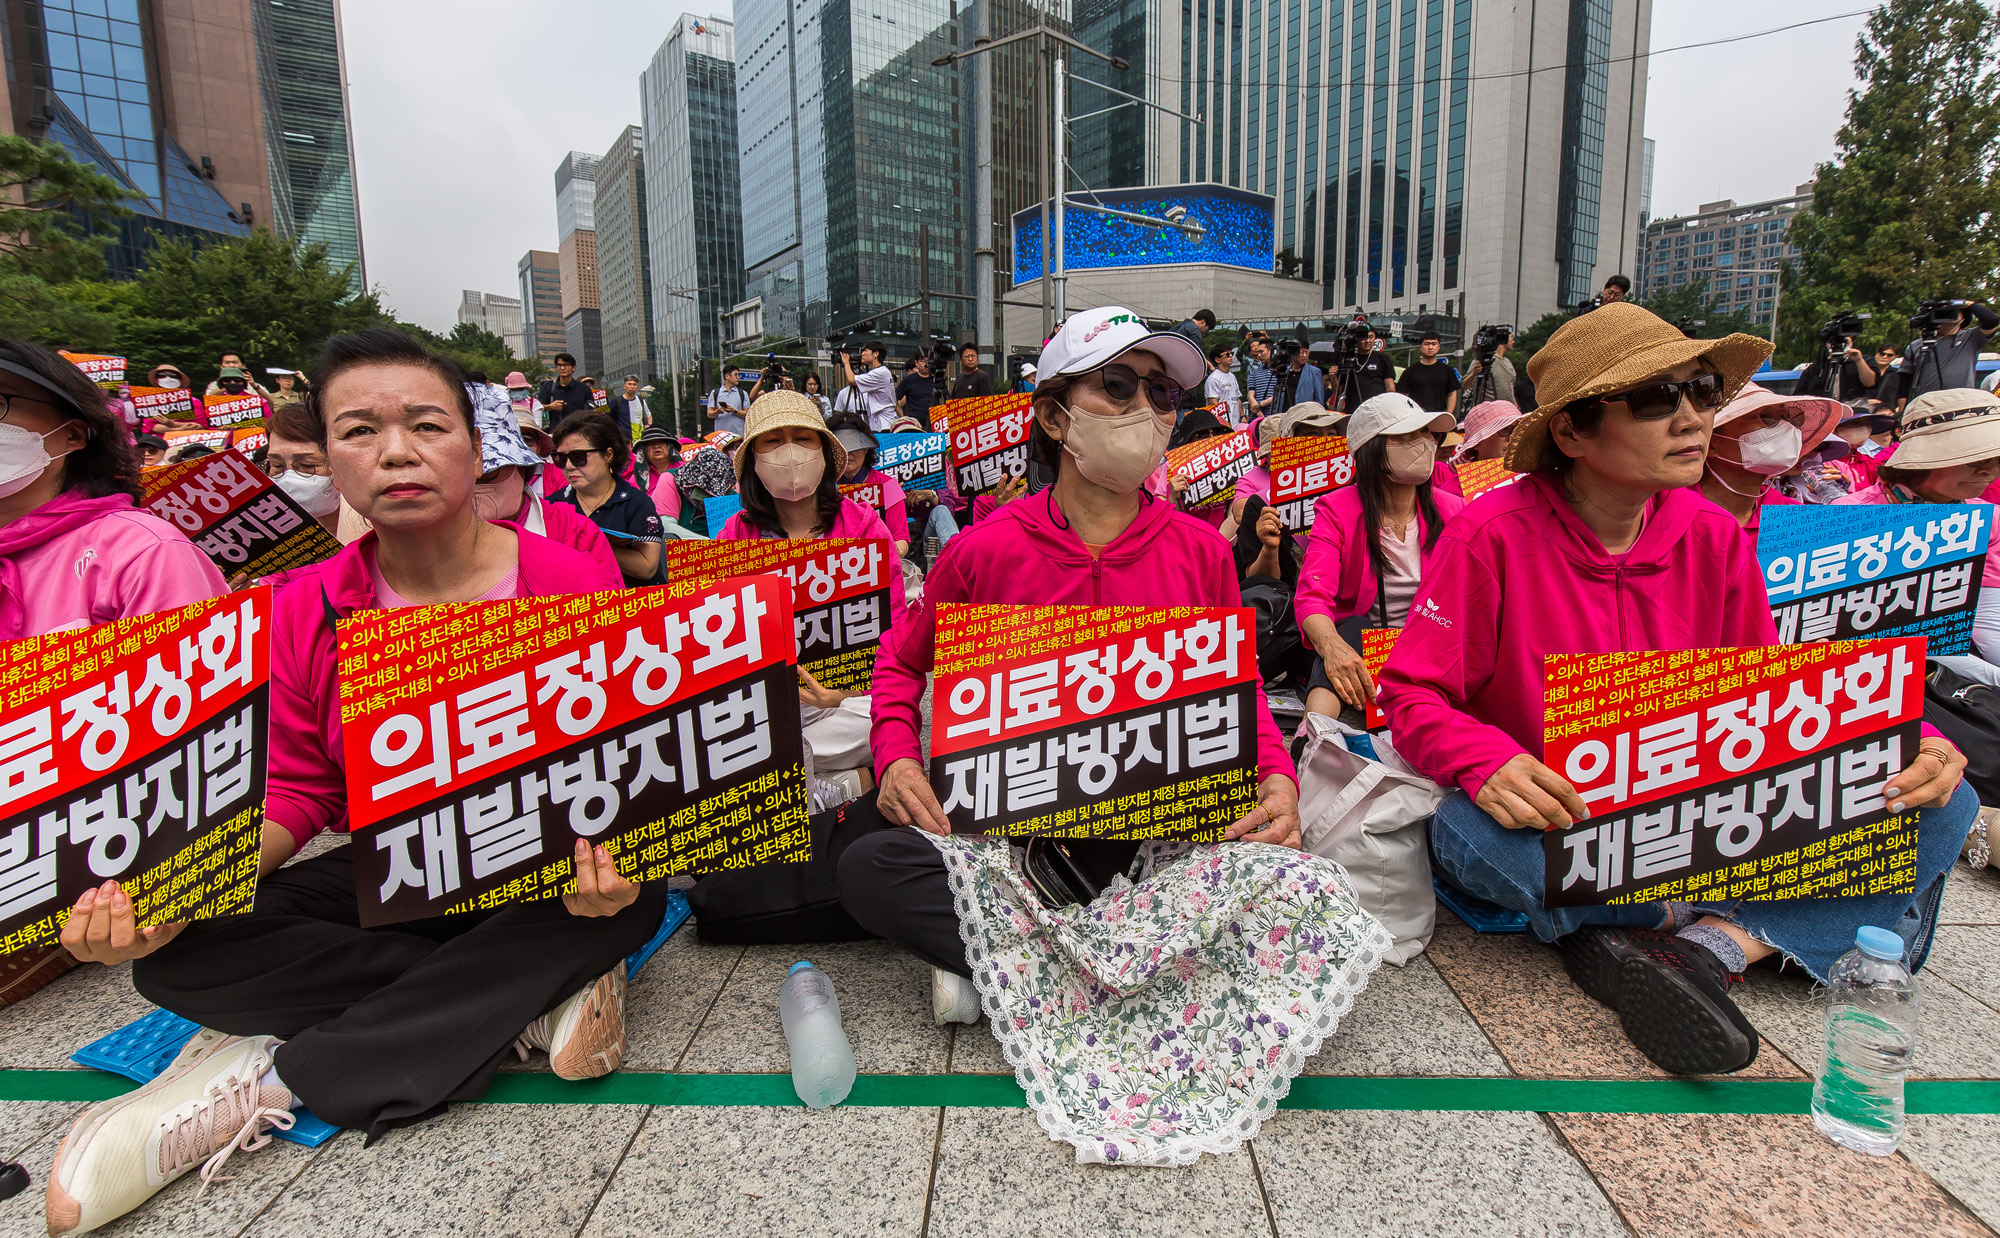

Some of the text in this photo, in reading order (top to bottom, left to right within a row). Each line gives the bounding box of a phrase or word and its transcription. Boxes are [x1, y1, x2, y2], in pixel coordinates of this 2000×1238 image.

[135, 389, 190, 406] 의료정상화
[208, 397, 262, 416] 의료정상화
[209, 408, 262, 426] 재발방지법
[959, 445, 1028, 491] 재발방
[1177, 432, 1250, 481] 의료정상화
[1184, 453, 1255, 504] 재발방지법
[1277, 454, 1355, 496] 의료정
[150, 454, 262, 531] 정상화
[196, 493, 303, 563] 방지법
[1766, 509, 1985, 596] 의료정상화
[945, 609, 968, 624] 의사
[965, 621, 987, 636] 의사
[990, 610, 1031, 632] 집단휴진
[1428, 612, 1452, 628] AHCC
[1771, 562, 1973, 645] 재발방지법
[7, 672, 67, 710] 집단휴진
[70, 657, 99, 685] 철회
[101, 647, 115, 669] 및
[117, 634, 142, 661] 재발
[144, 614, 180, 646] 방지법
[40, 624, 116, 677] 철회 및 재발
[340, 594, 592, 699] 촉구대회 의사 집단휴진 철회 및 재발
[341, 592, 665, 725] 환자촉구대회 의사 집단휴진 철회 및 재발 방지법
[352, 623, 384, 648] 의사
[384, 635, 416, 660] 의사
[419, 612, 479, 649] 집단휴진
[934, 608, 1111, 661] 촉구대회 의사 집단휴진 철회 및 재발
[934, 610, 1166, 679] 환자촉구대회 의사 집단휴진 철회 및 재발 방지법
[369, 583, 767, 802] 의료정상화
[947, 614, 1245, 738] 의료정상화
[1544, 684, 1569, 703] 대회
[1582, 674, 1610, 692] 의사
[1612, 657, 1665, 686] 집단휴진
[1544, 649, 1765, 722] 촉구대회 의사 집단휴진 철회 및 재발
[1544, 649, 1826, 743] 환자촉구대회 의사 집단휴진 철회 및 재발 방지법
[1556, 661, 1584, 680] 의사
[1565, 645, 1913, 804] 의료정상화
[943, 693, 1240, 821] 재발방지법
[375, 678, 771, 904] 재발방지법
[624, 769, 779, 849] 방지법 제정 환자촉구대회
[1054, 808, 1076, 827] 철회
[1079, 805, 1090, 820] 및
[1092, 799, 1115, 816] 재발
[1117, 790, 1150, 811] 방지법
[1152, 784, 1175, 801] 제정
[1177, 768, 1243, 796] 환자촉구대회
[1092, 814, 1125, 835] 방지법
[1128, 808, 1150, 825] 제정
[1153, 792, 1218, 820] 환자촉구대회
[1230, 784, 1252, 800] 의사
[1208, 807, 1231, 823] 의사
[1562, 735, 1901, 892] 재발방지법
[143, 810, 251, 891] 방지법 제정 환자촉구대회
[640, 786, 793, 865] 제정 환자촉구대회 의사
[742, 819, 769, 844] 의사
[151, 829, 256, 907] 제정 환자촉구대회 의사
[212, 865, 235, 891] 의사
[540, 857, 571, 883] 철회
[1633, 815, 1902, 903] 집단휴진 철회 및 재발 방지법 제정 환자촉구대회
[1730, 875, 1769, 898] 방지법
[1772, 867, 1798, 886] 제정
[1800, 843, 1872, 879] 환자촉구대회
[1885, 831, 1911, 850] 의사
[1860, 858, 1886, 876] 의사
